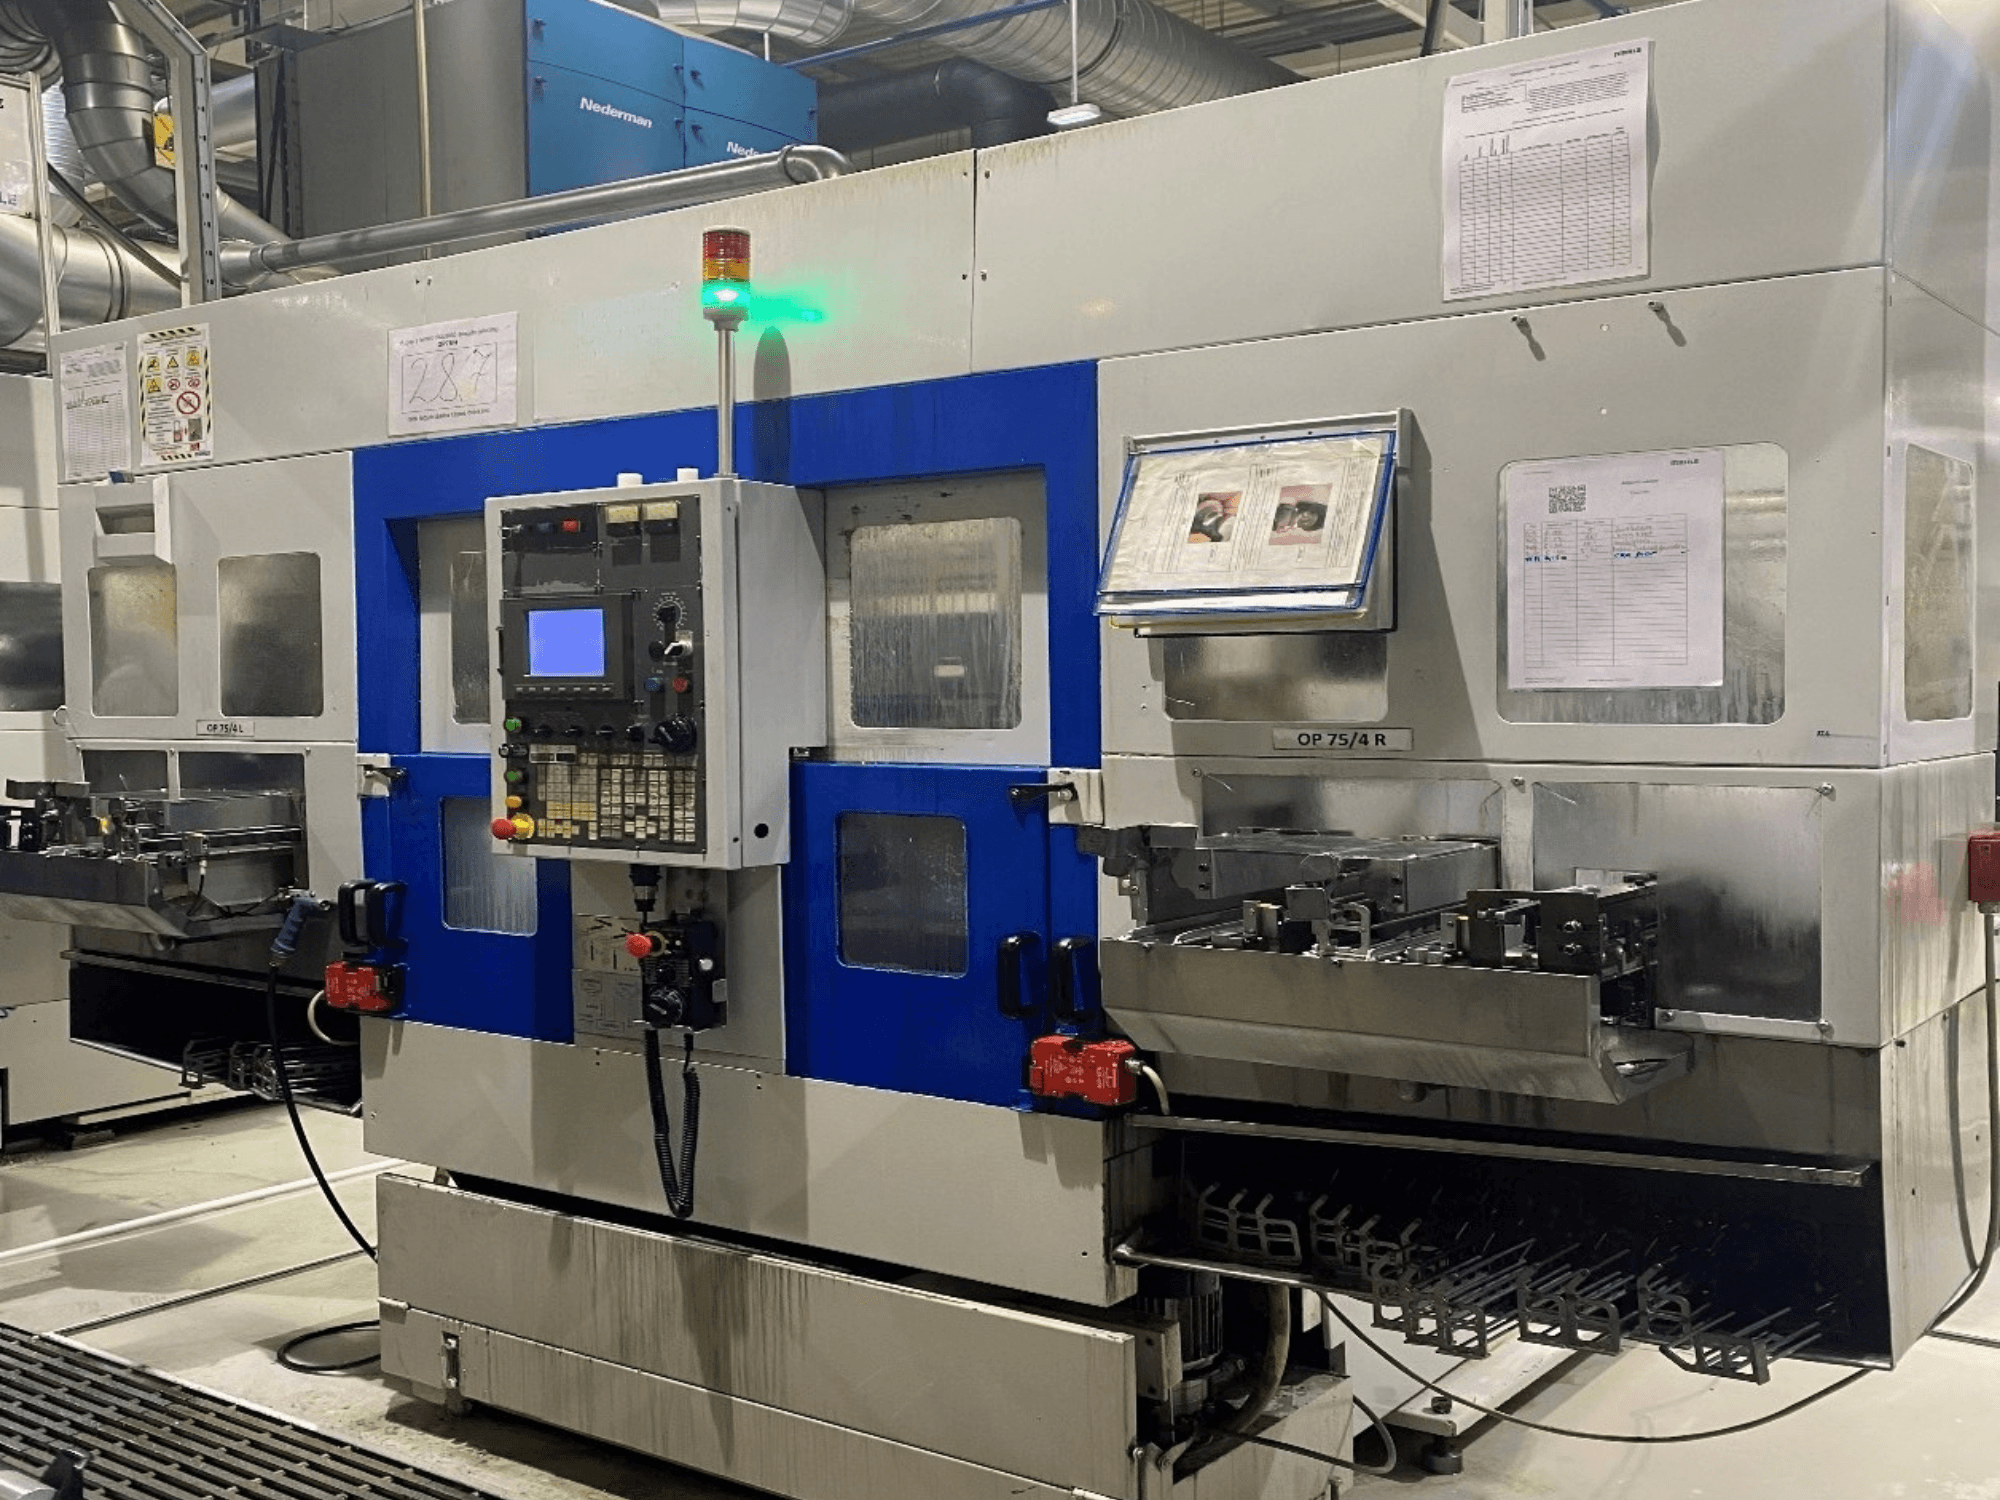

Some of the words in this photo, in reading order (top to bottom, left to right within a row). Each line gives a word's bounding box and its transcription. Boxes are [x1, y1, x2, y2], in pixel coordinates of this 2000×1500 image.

[580, 96, 653, 128] Nederman
[219, 722, 238, 733] 75/4
[1297, 733, 1322, 746] OP
[1327, 731, 1370, 749] 75/4
[1374, 733, 1387, 746] R
